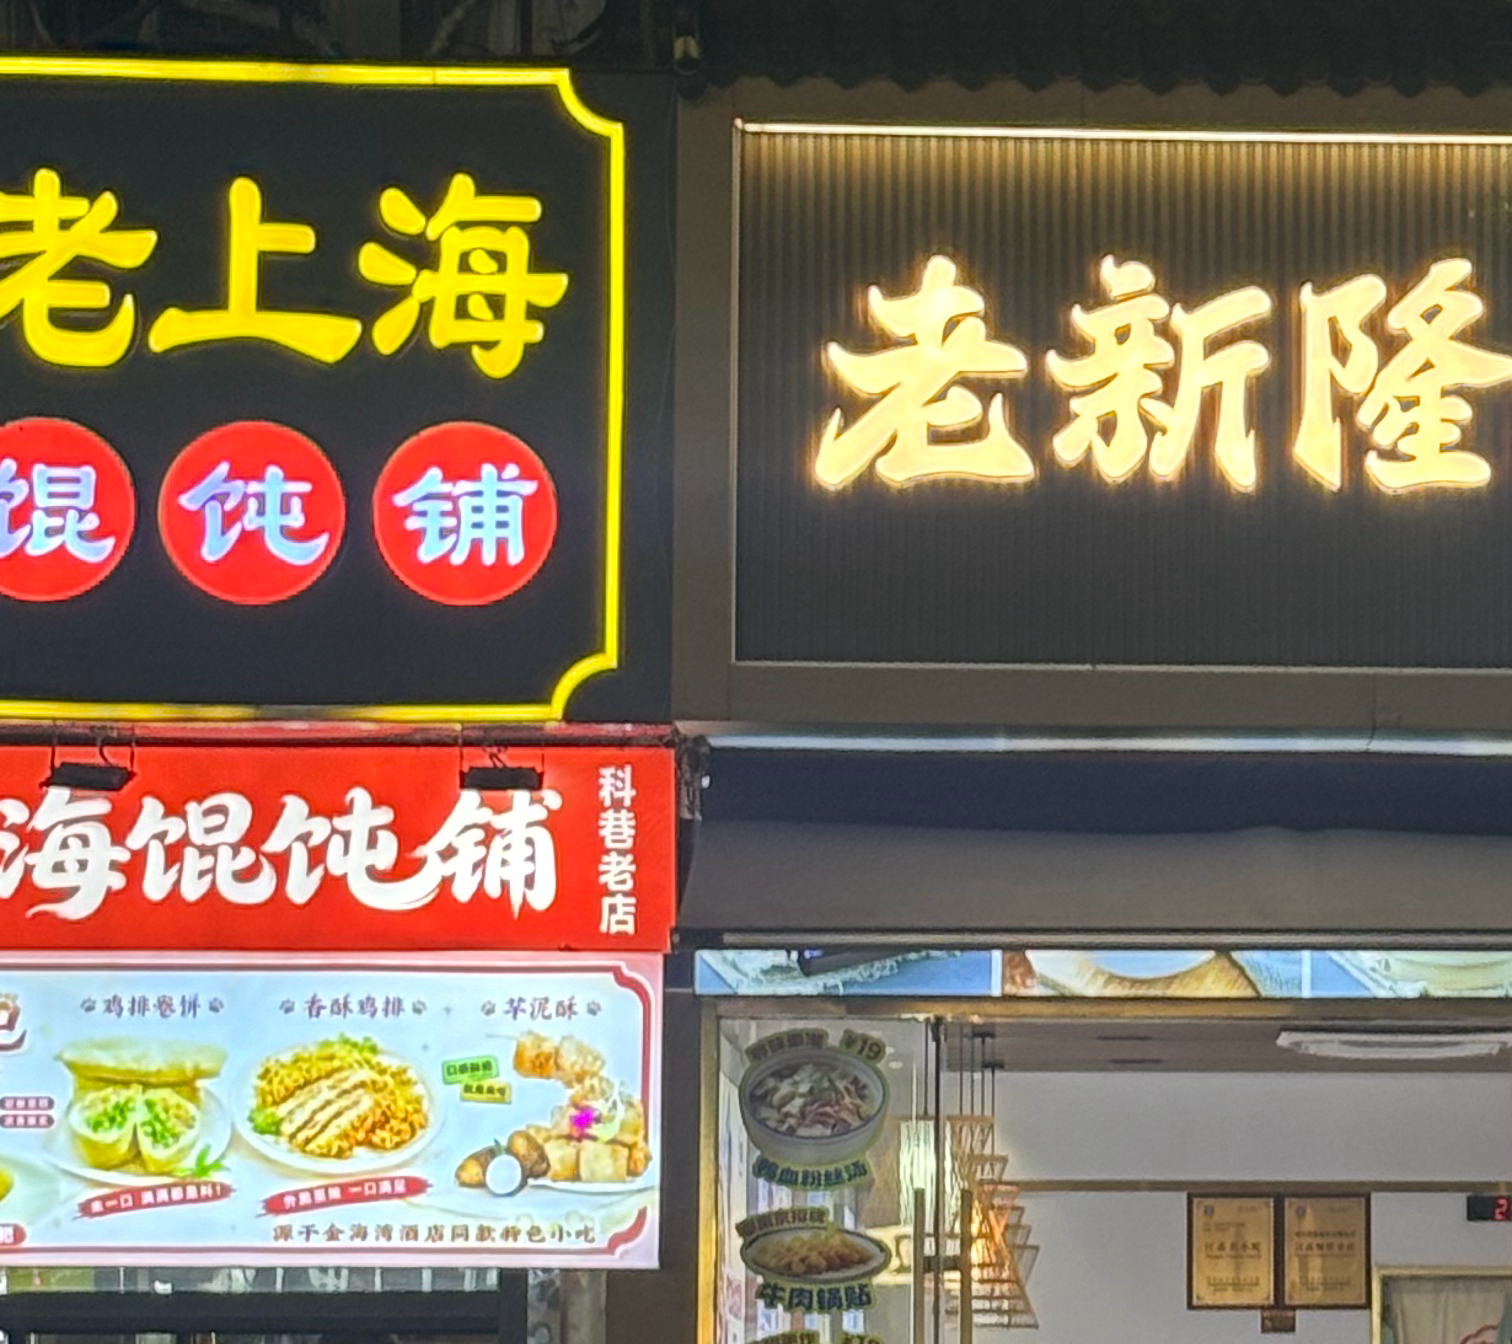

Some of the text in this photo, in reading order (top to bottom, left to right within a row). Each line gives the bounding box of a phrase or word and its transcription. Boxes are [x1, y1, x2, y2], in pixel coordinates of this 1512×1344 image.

[0, 168, 568, 377] 老上海
[0, 461, 538, 567] 馄饨铺
[0, 786, 562, 920] 海馄饨铺
[598, 764, 638, 935] 科巷老店
[102, 994, 202, 1019] 鸡排卷饼
[303, 993, 406, 1020] 香酥鸡排
[504, 996, 579, 1020] 芋泥酥
[756, 1282, 873, 1312] 牛肉锅贴
